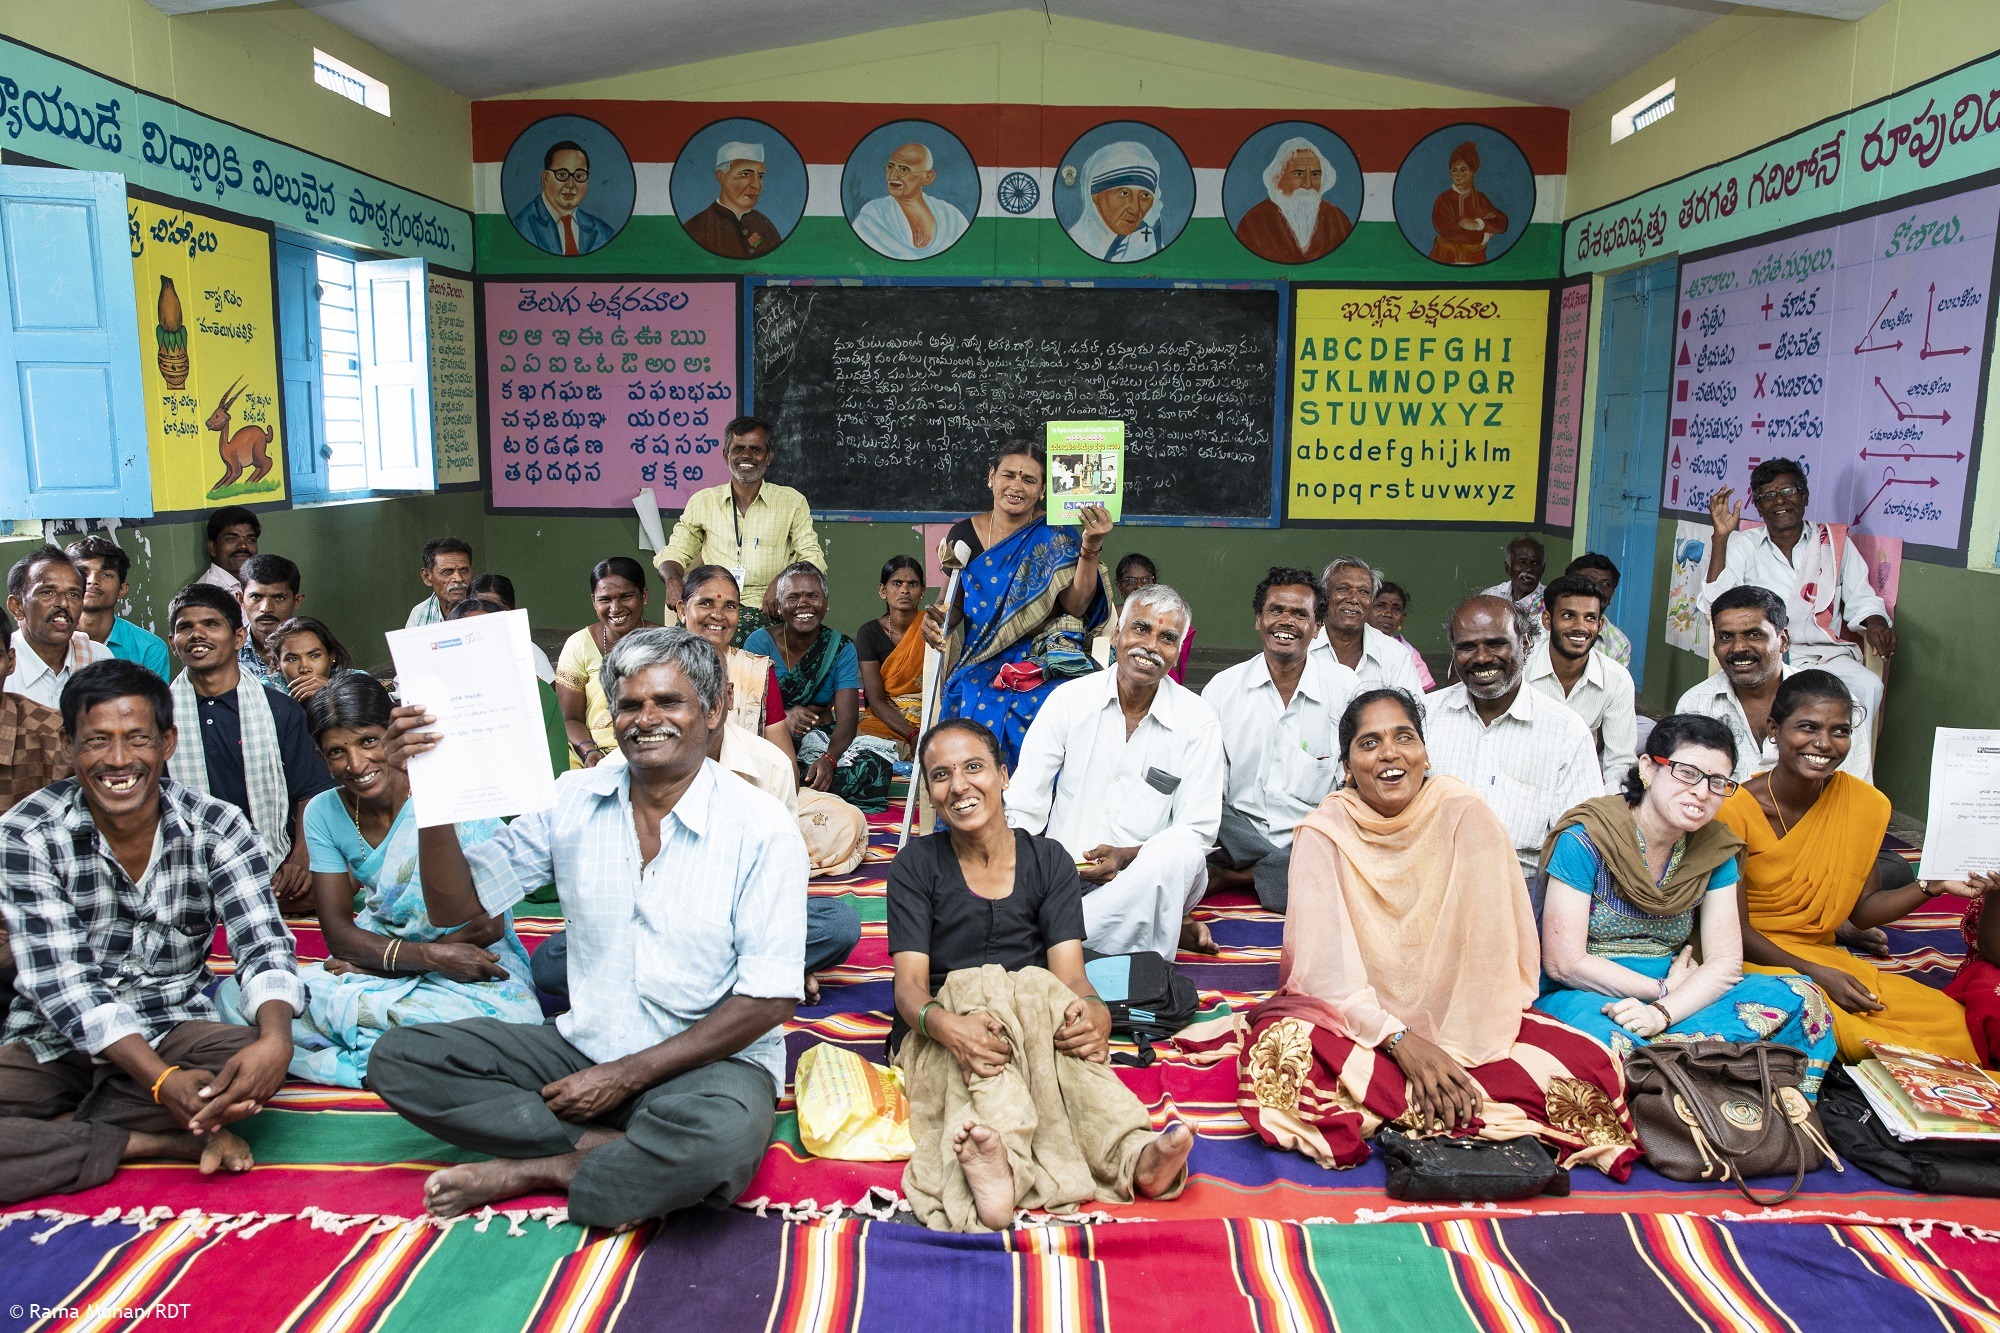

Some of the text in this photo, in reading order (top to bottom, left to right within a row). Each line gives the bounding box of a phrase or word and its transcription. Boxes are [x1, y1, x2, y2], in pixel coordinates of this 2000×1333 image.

[142, 122, 243, 201] విద్యార్థికి
[253, 160, 335, 225] విలువైన
[349, 188, 456, 252] పాఠ్యగ్రంథము.
[1577, 207, 1667, 261] దేశభవిష్యత్తు
[1678, 176, 1739, 230] తరగతి
[1747, 130, 1847, 209] గదిలోనే
[1885, 214, 1964, 259] కోణాలు.
[517, 286, 690, 320] తెలుగు అక్షరమాల
[1406, 294, 1501, 328] అక్షరమాల.
